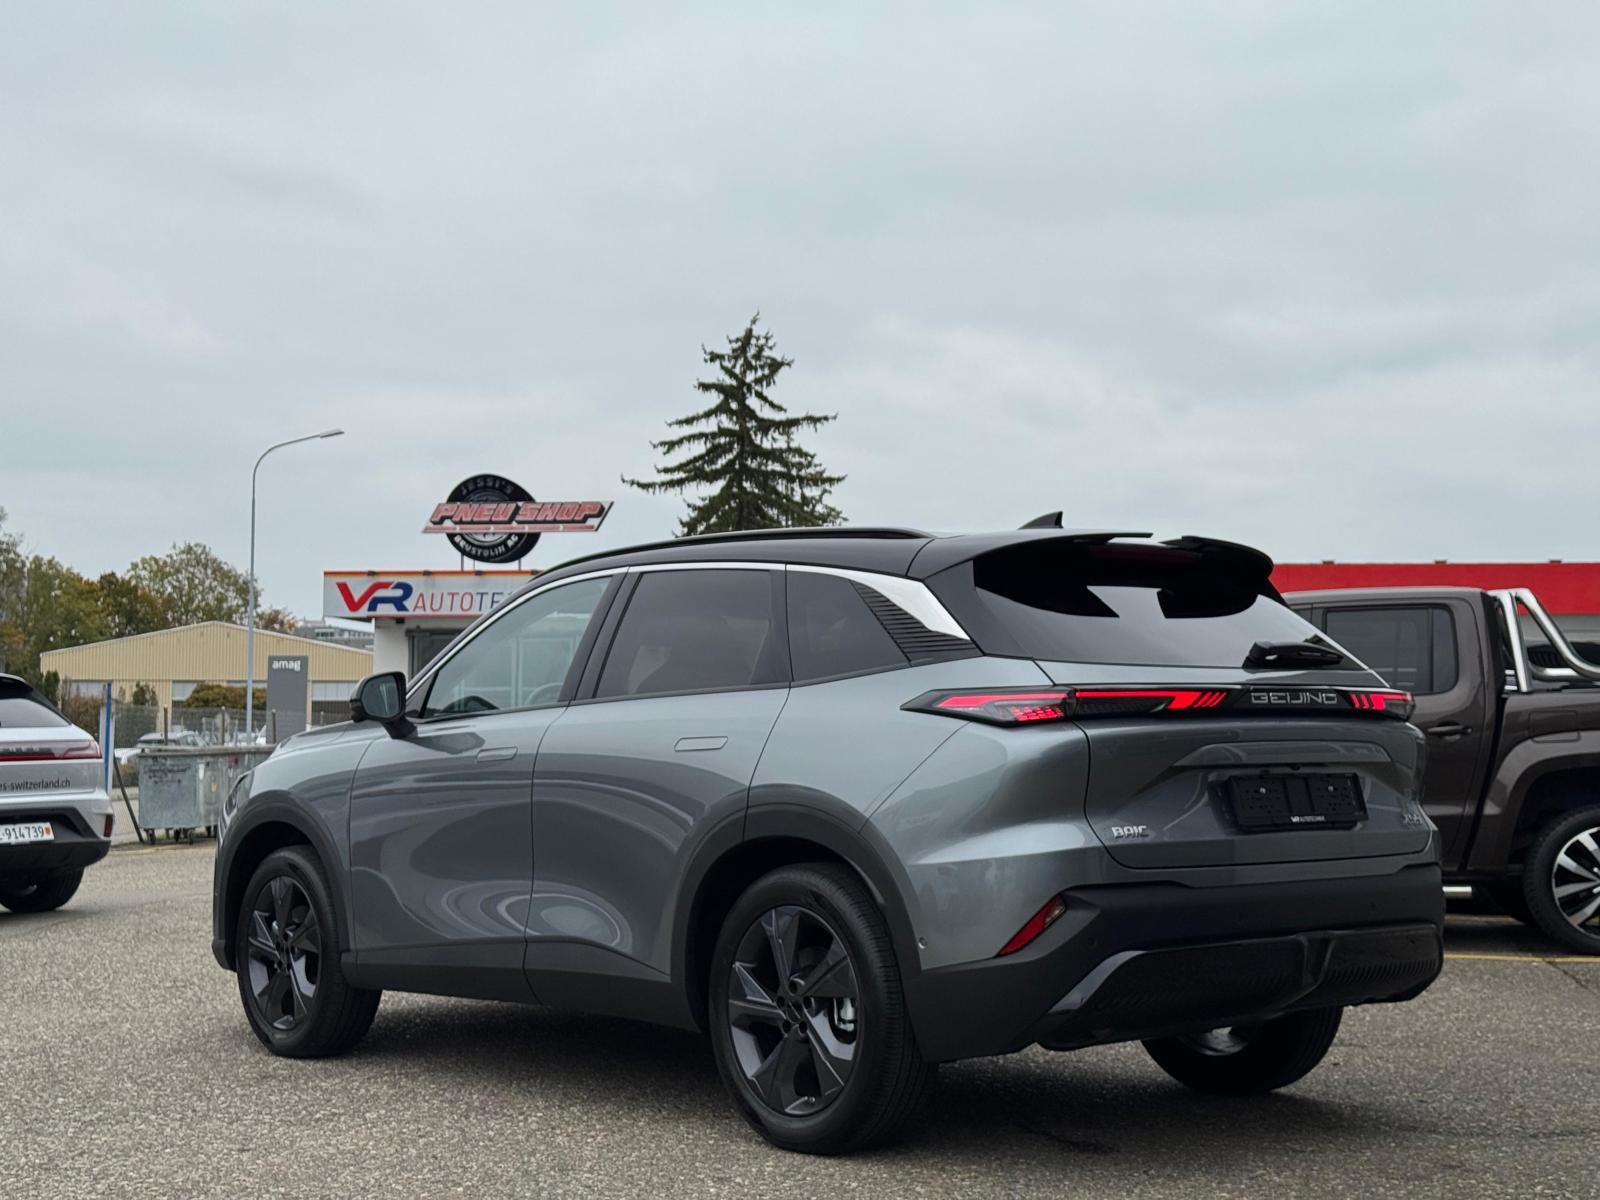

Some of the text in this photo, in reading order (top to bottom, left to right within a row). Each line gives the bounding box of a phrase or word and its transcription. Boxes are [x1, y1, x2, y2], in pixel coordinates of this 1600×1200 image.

[430, 501, 605, 524] PNEU SHOP
[336, 581, 414, 612] VR
[272, 660, 301, 671] amag
[1111, 825, 1148, 838] BAIC
